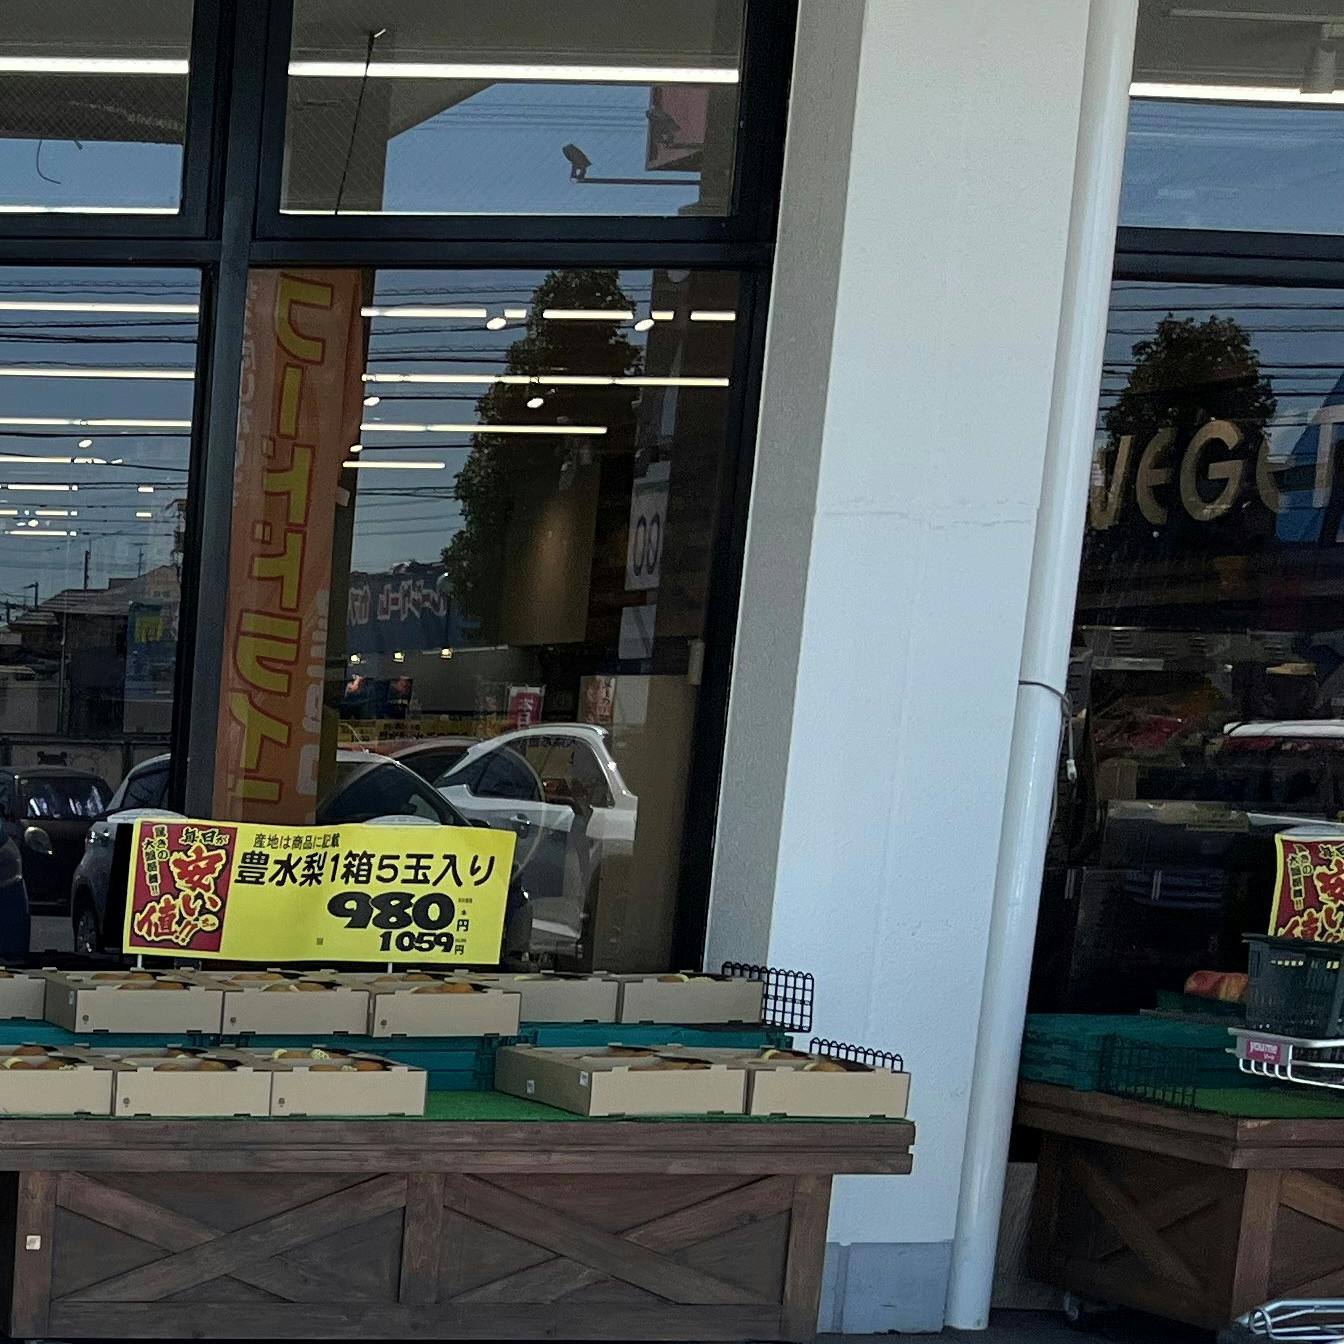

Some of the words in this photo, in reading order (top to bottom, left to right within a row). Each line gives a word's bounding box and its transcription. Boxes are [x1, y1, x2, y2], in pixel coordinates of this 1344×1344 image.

[252, 833, 341, 850] 産地は商品に記載
[234, 850, 497, 888] 豊水梨1箱5玉入り
[327, 891, 456, 931] 980
[379, 931, 454, 953] 1059
